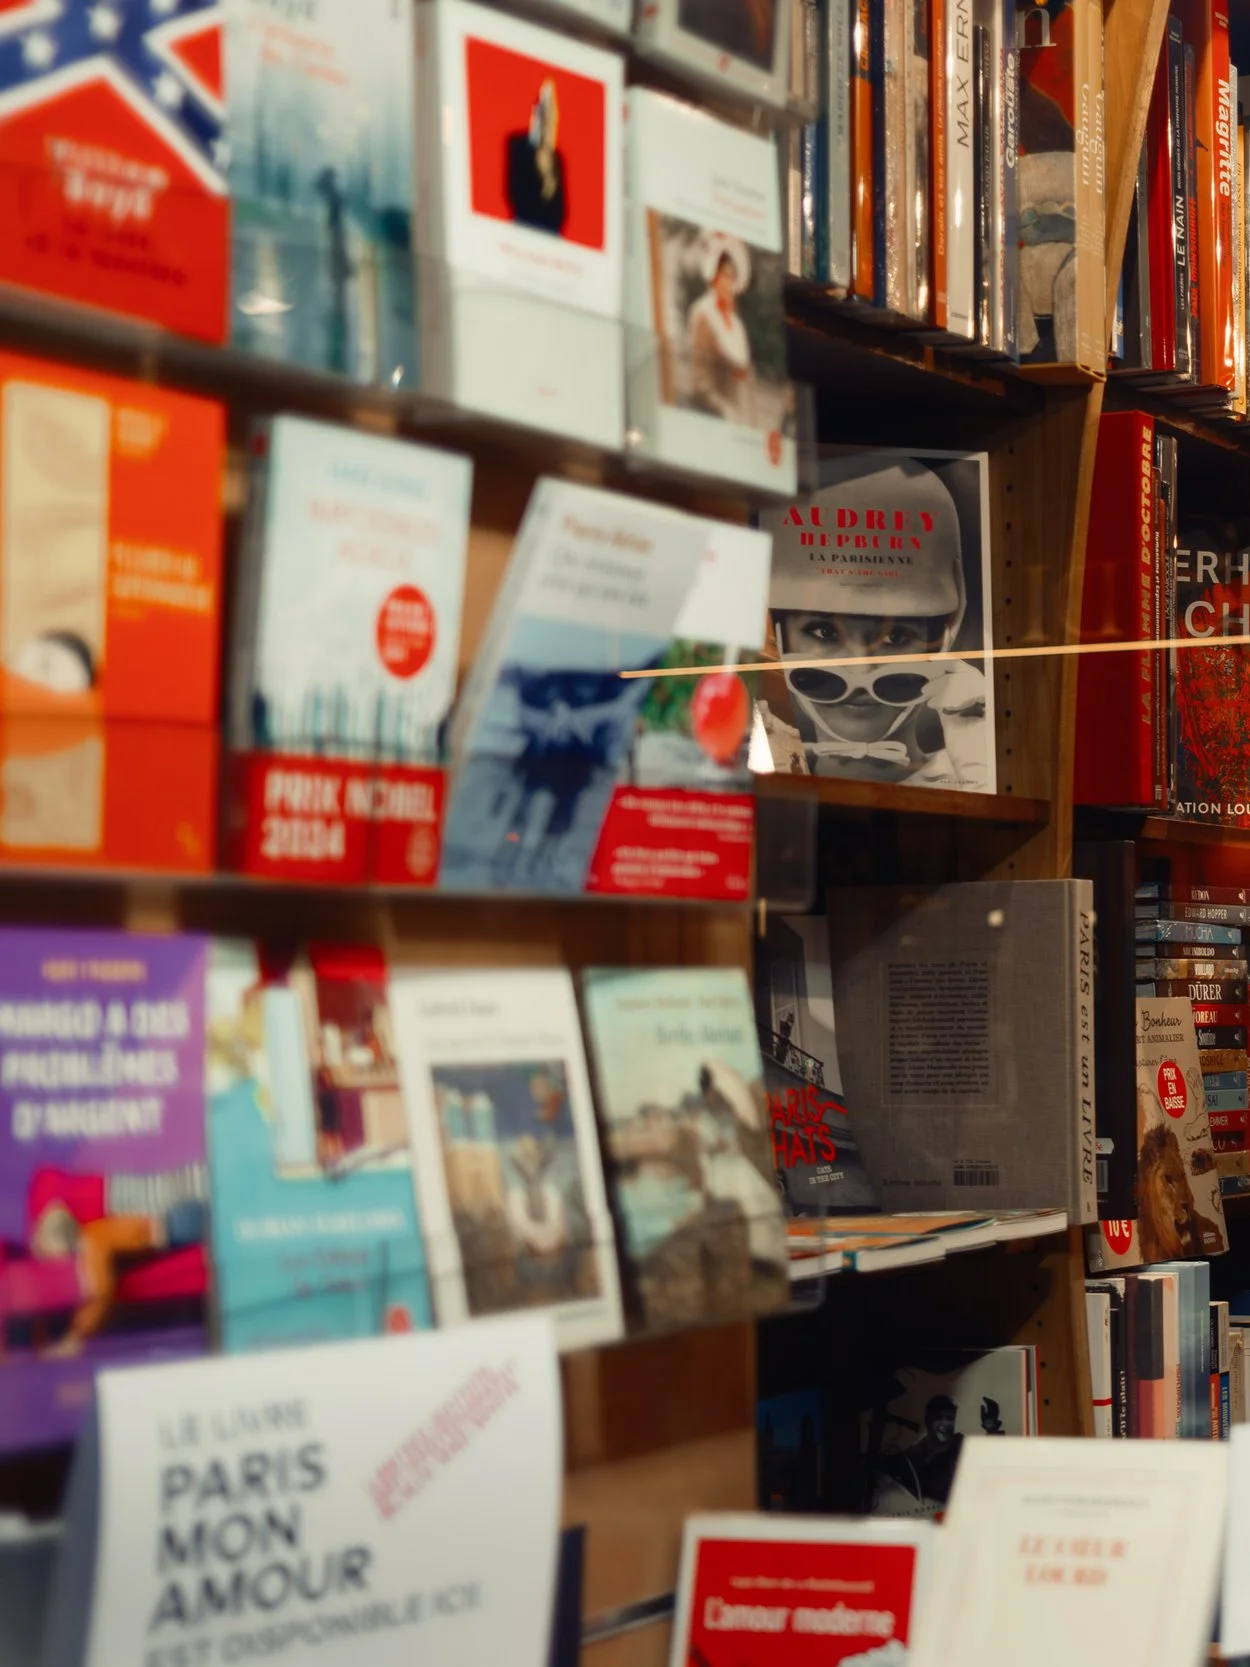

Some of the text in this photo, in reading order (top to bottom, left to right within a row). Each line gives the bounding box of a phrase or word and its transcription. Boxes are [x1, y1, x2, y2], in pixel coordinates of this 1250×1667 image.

[956, 74, 970, 148] MAX
[1005, 52, 1016, 170] Garouste
[1217, 77, 1232, 198] Magritte
[1175, 194, 1186, 241] NAIN
[1176, 244, 1186, 268] LE
[1140, 425, 1153, 567] D'OCTOBRE
[783, 505, 939, 533] AUDREY
[800, 532, 922, 551] HEPBURN
[809, 552, 915, 566] LA PARISIENNE
[265, 768, 344, 811] PRIX
[261, 817, 347, 861] 2024
[1184, 906, 1228, 920] EDWARD HOPPER
[1184, 925, 1214, 941] MUCHA
[1188, 982, 1222, 1001] DÜRER
[1141, 1008, 1182, 1032] Bonheur
[1079, 911, 1094, 1186] PARIS est un LIVRE
[1147, 1033, 1185, 1043] ANIMALIER
[1162, 1067, 1177, 1081] PRIX
[1167, 1082, 1177, 1095] EN
[1164, 1095, 1186, 1110] BAISSE
[158, 1397, 310, 1449] LE LIVRE
[160, 1442, 326, 1511] PARIS
[155, 1505, 300, 1577] MON
[147, 1546, 374, 1635] AMOUR
